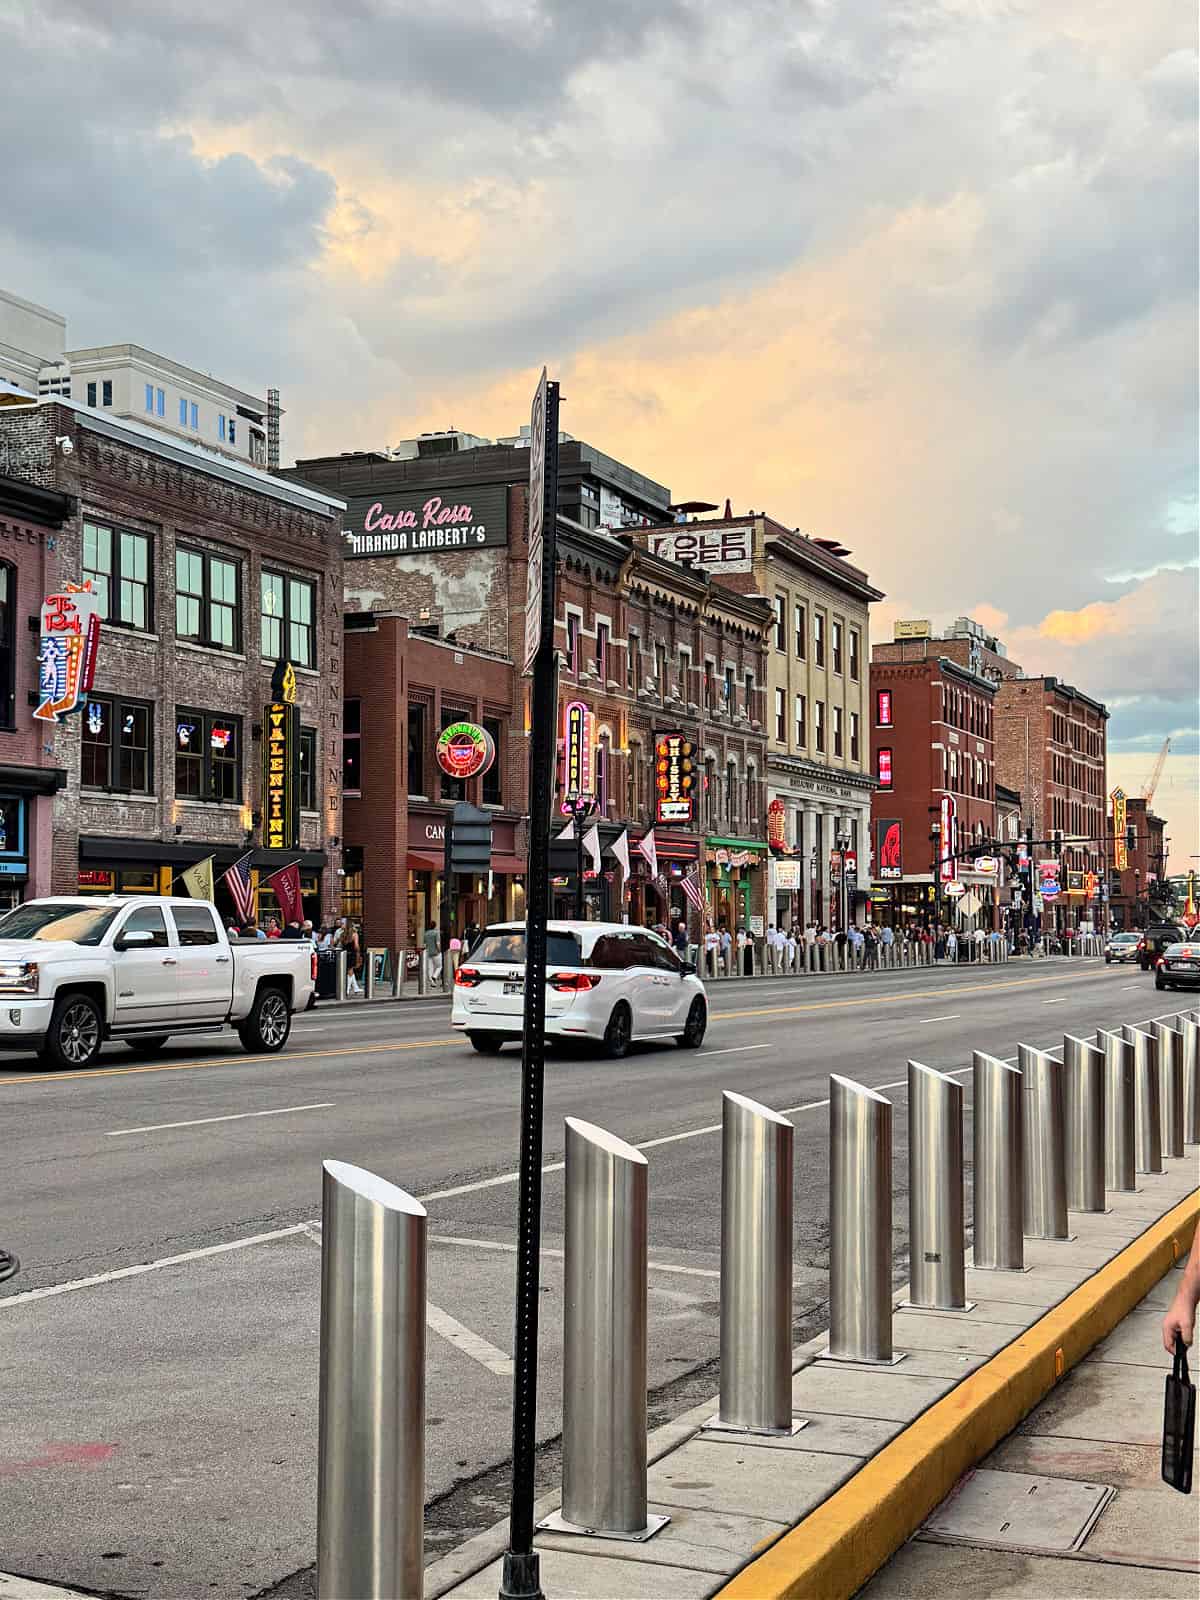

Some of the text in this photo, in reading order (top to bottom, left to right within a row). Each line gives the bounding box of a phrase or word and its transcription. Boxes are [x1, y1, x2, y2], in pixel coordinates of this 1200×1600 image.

[352, 525, 486, 553] MIRANDA LAMBERT'S
[364, 497, 473, 531] Casa Rosa
[674, 532, 746, 549] OLE
[329, 574, 340, 811] VALENTINE
[269, 713, 285, 848] VALENTINE
[570, 710, 580, 793] MIRANDA
[668, 738, 681, 802] WHISKEY
